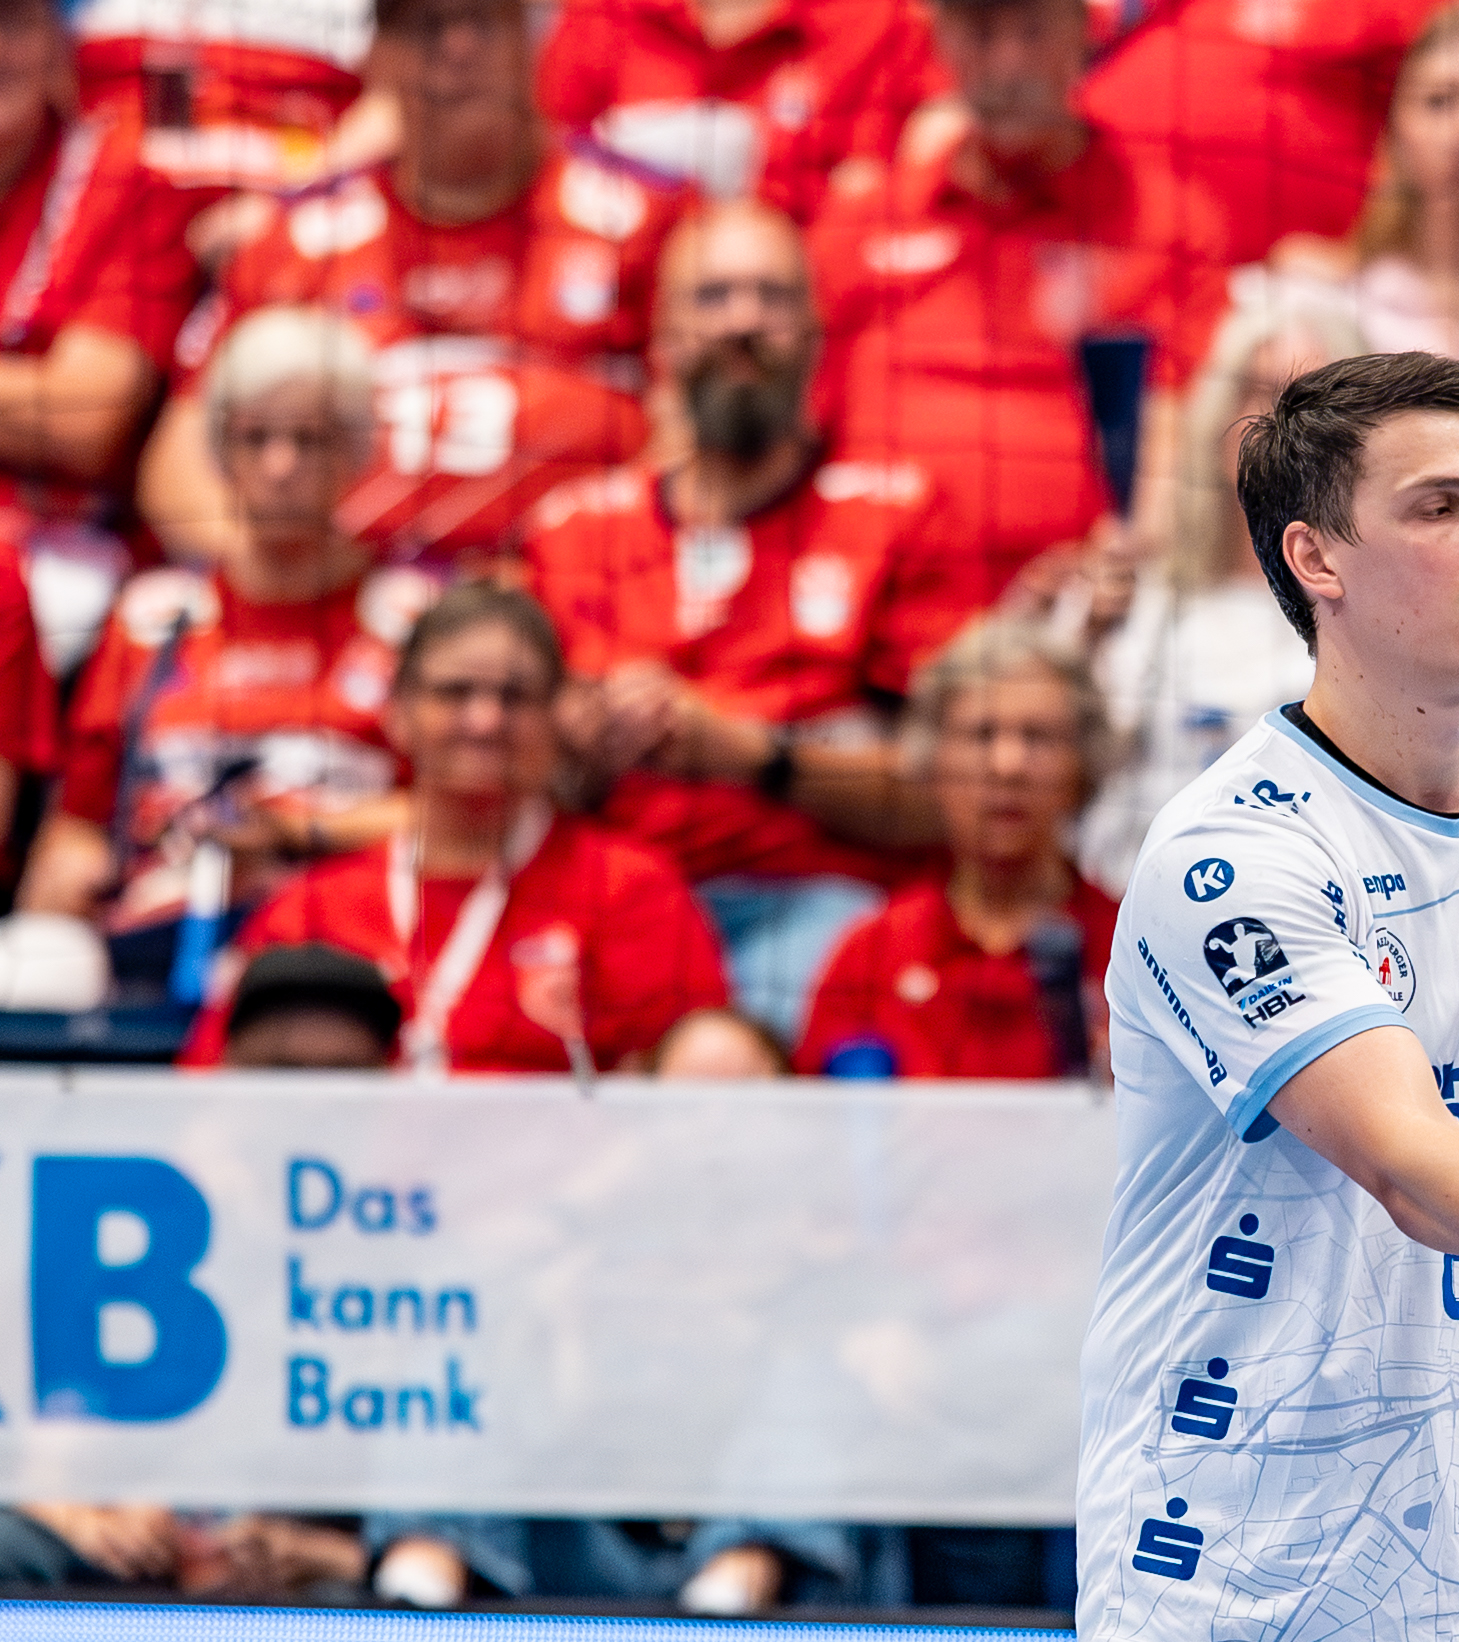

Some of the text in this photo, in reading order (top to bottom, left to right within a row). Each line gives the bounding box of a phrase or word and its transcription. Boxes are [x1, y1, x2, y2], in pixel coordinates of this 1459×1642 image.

[1242, 989, 1307, 1030] HBL
[285, 1158, 438, 1234] Das
[30, 1154, 230, 1424] B
[285, 1252, 478, 1332] kann
[287, 1353, 481, 1433] Bank
